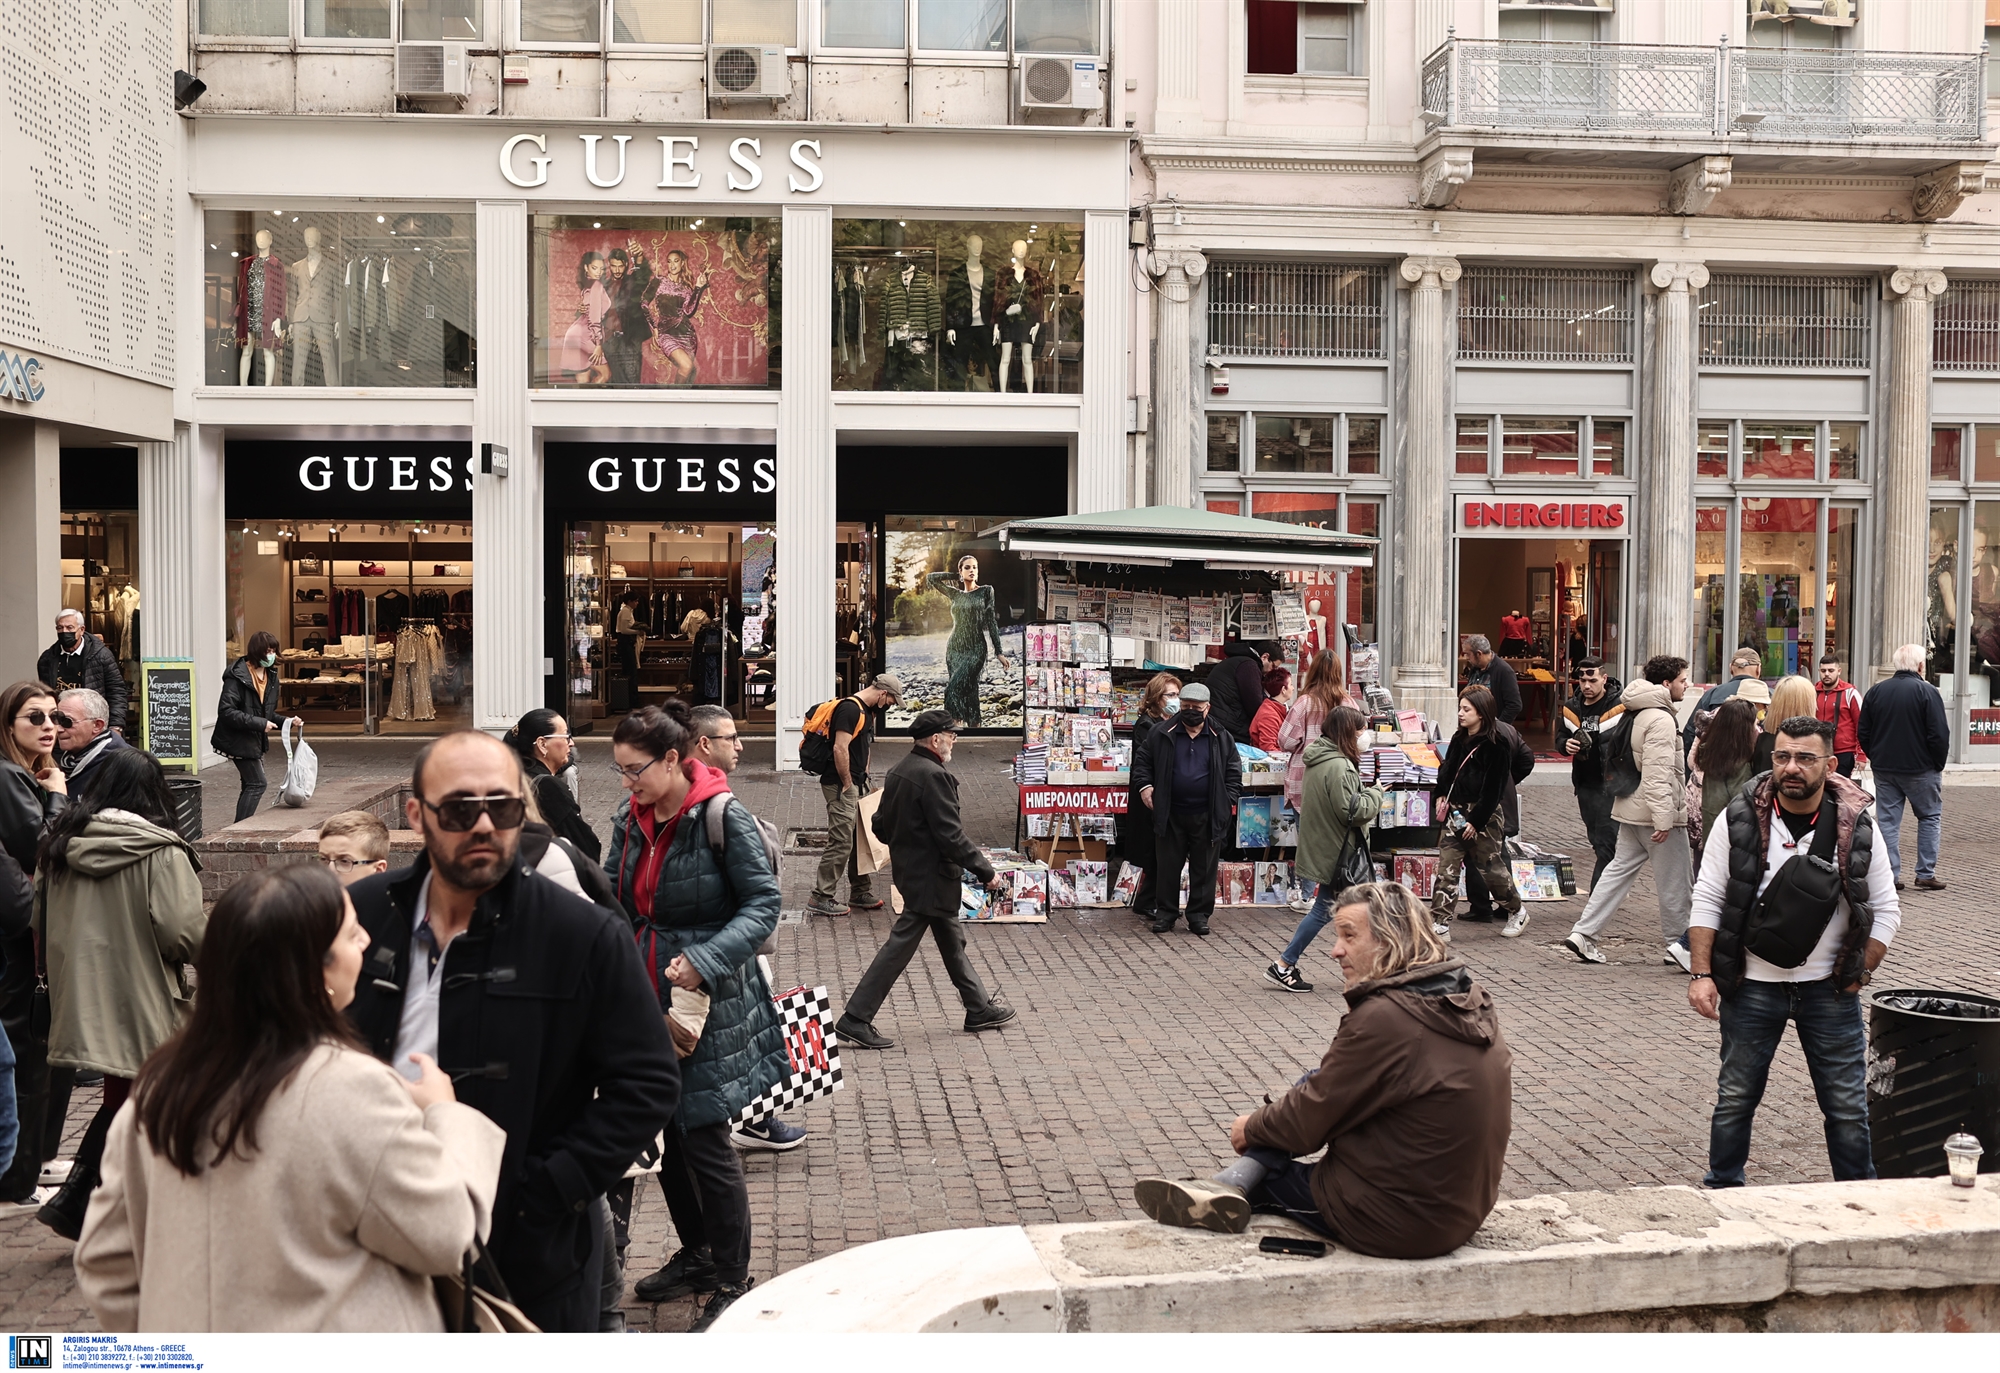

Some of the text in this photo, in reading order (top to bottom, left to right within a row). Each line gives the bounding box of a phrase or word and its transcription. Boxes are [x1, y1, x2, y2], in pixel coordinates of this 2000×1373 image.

[499, 133, 824, 193] GUESS
[299, 456, 473, 492] GUES
[587, 457, 776, 493] GUESS
[1464, 502, 1624, 528] ENERGIERS
